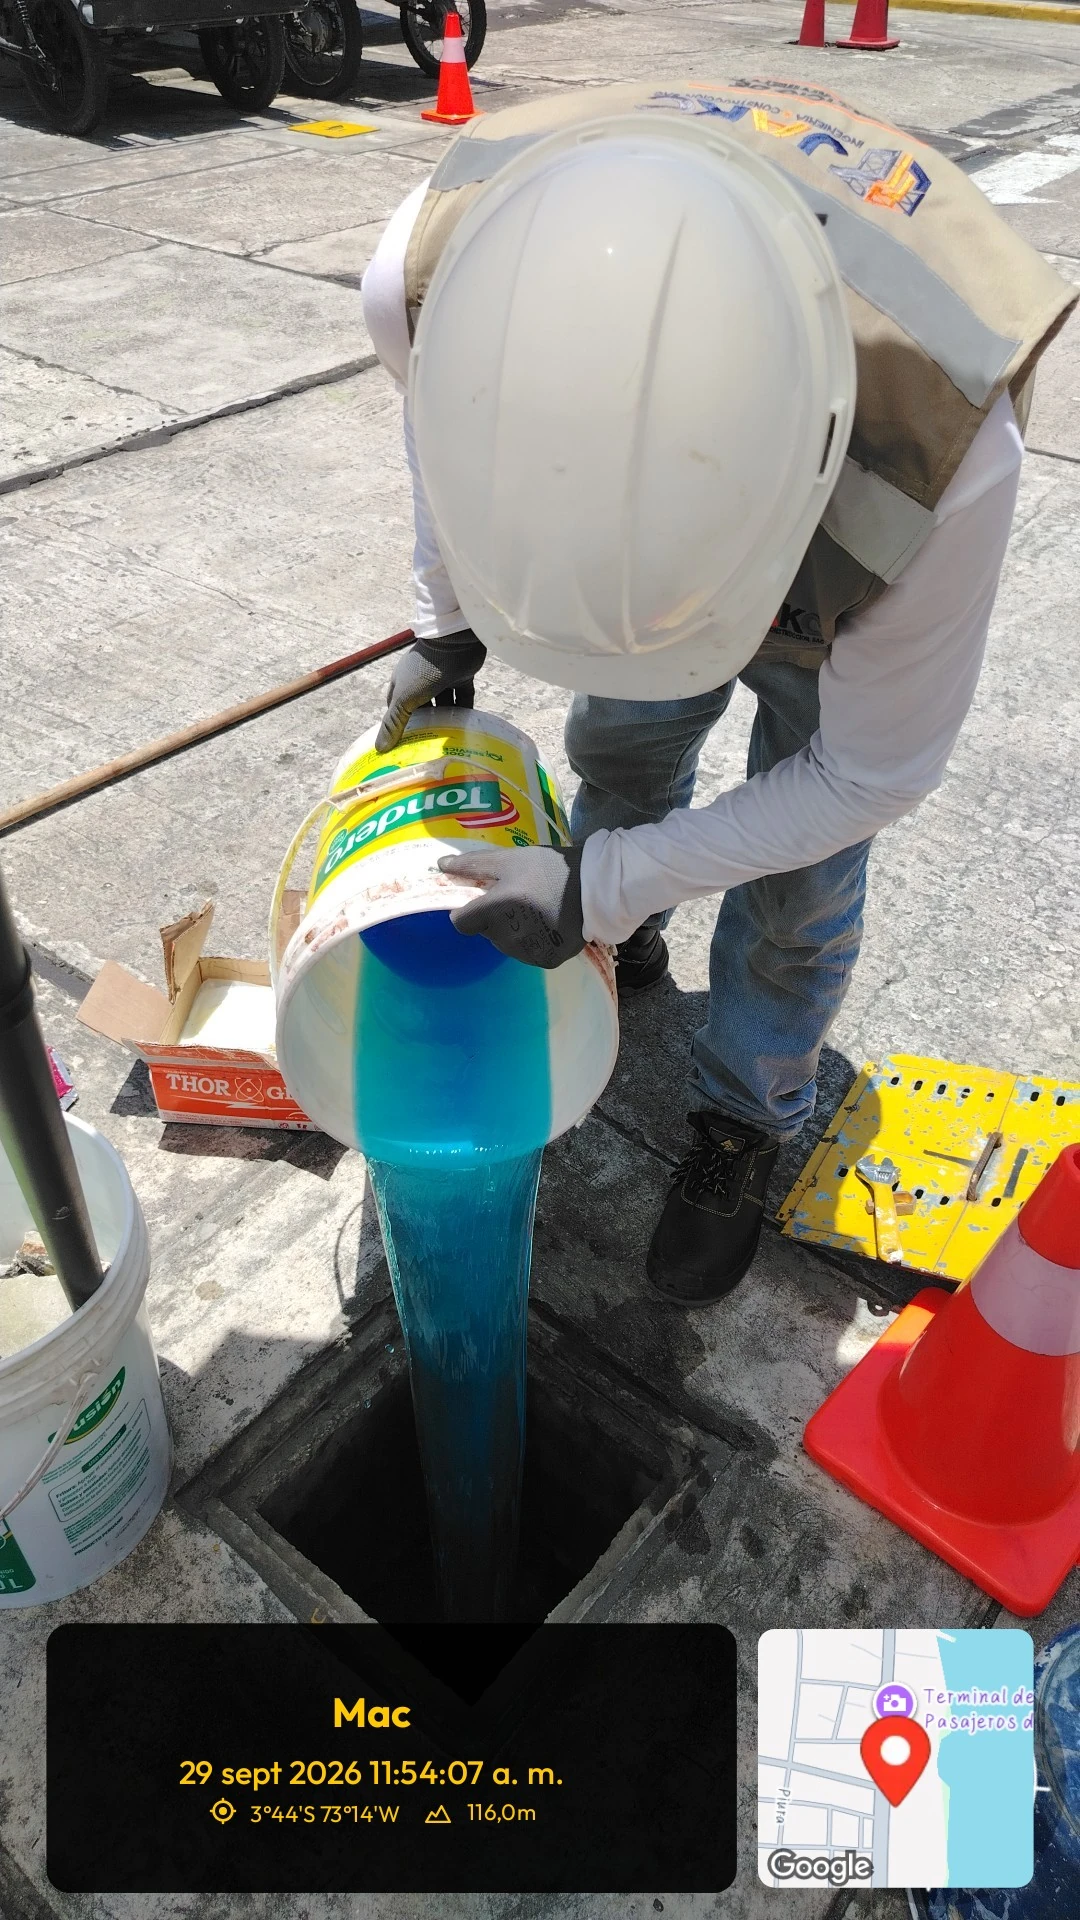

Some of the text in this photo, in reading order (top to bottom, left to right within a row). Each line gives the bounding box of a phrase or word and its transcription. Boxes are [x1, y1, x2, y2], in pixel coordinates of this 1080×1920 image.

[796, 114, 865, 148] INGENIERIA
[324, 787, 492, 875] Tondero
[166, 1073, 231, 1097] THOR
[72, 1378, 121, 1431] usión
[75, 1536, 102, 1555] PRODUCTO
